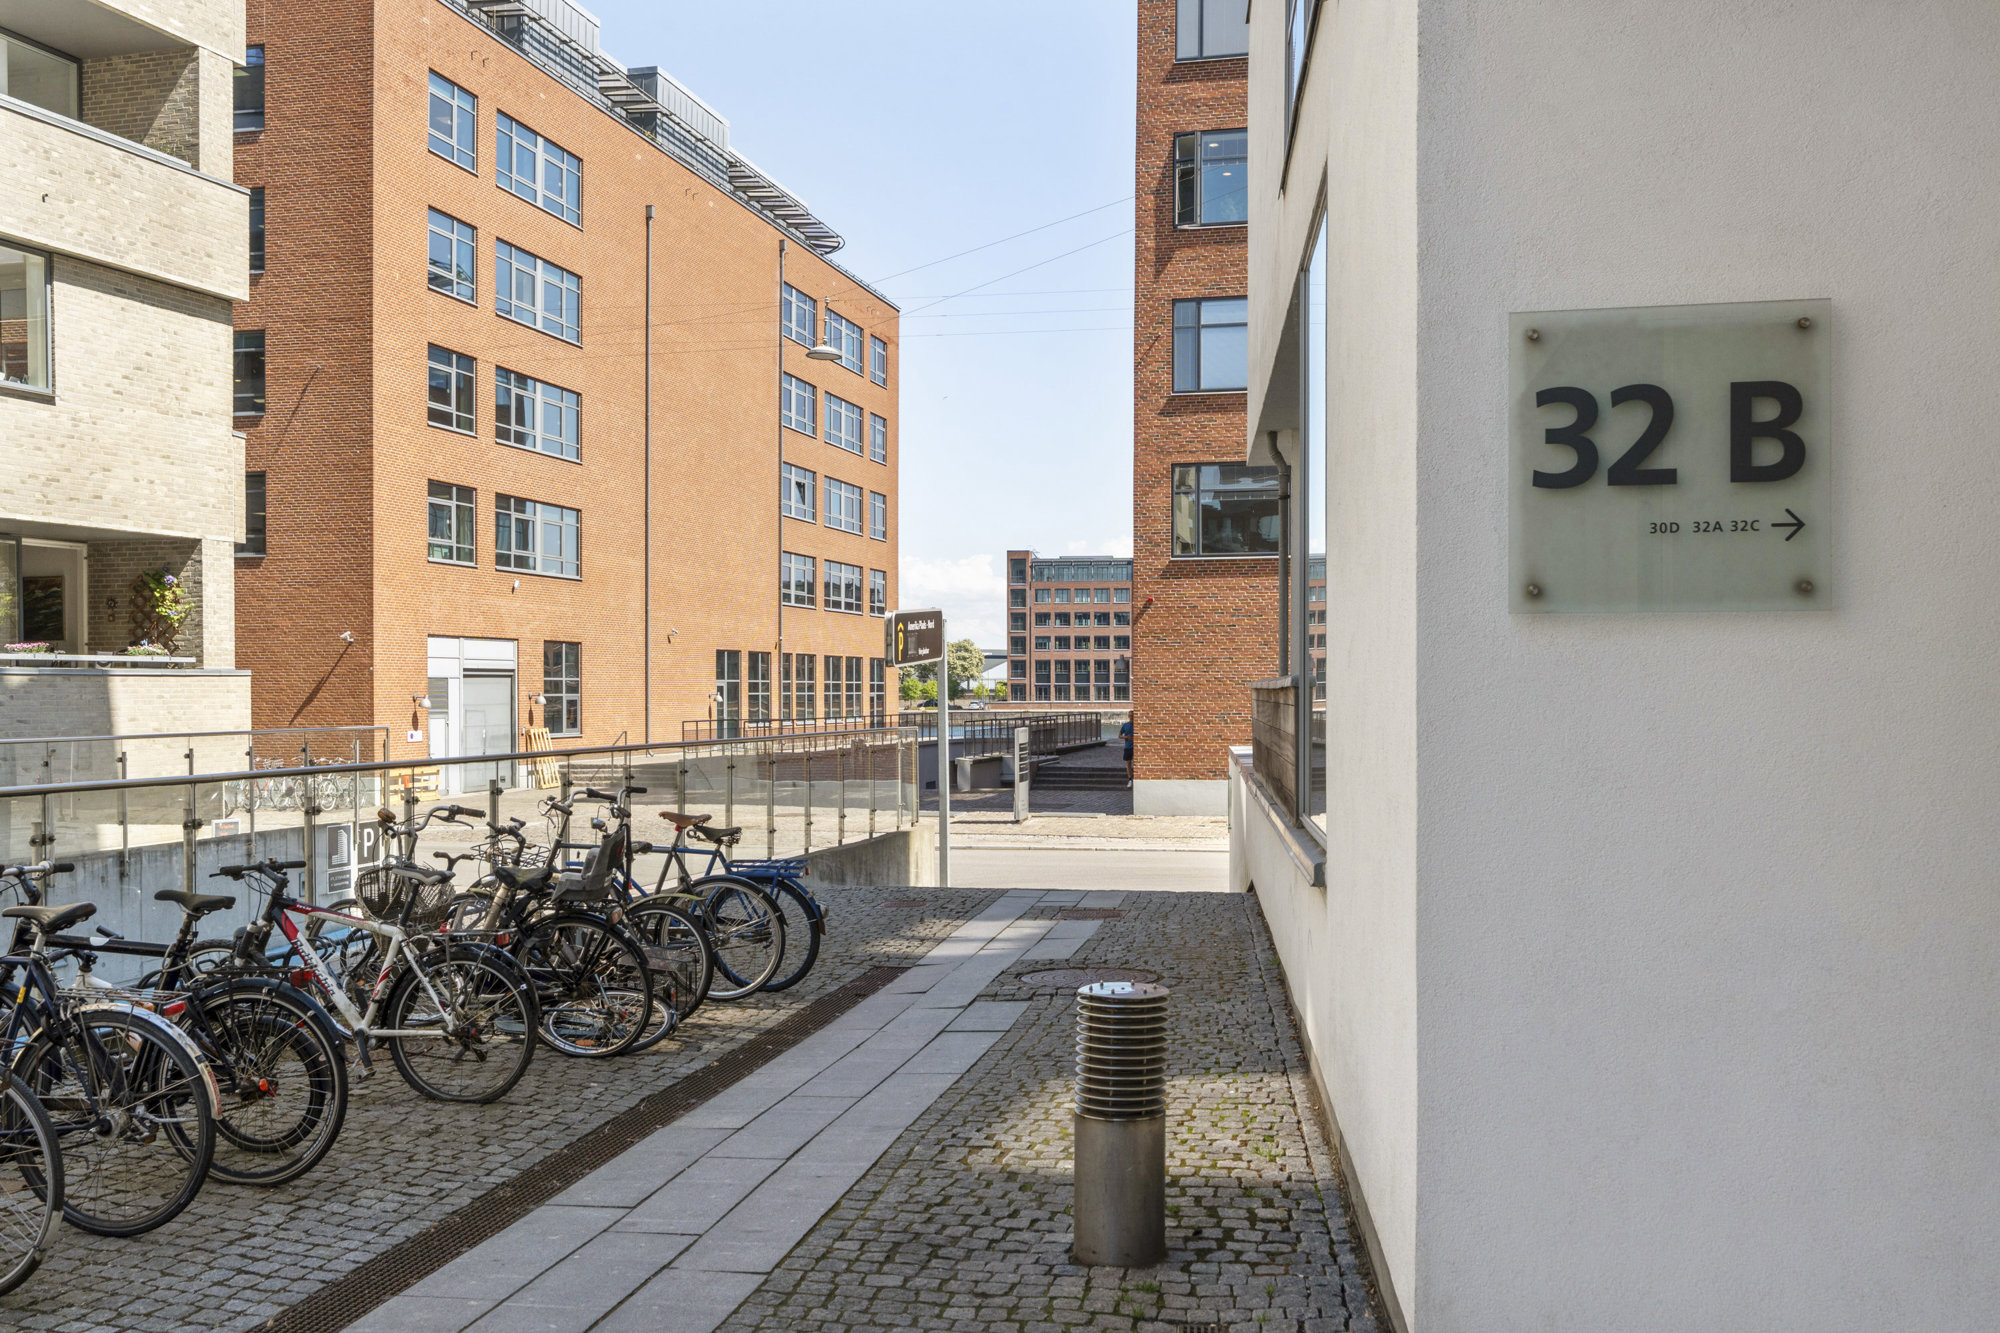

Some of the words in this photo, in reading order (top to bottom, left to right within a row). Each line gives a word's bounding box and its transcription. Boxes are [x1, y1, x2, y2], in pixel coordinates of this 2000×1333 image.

[1532, 383, 1678, 489] 32
[1730, 380, 1806, 484] B
[1649, 521, 1680, 534] 30D
[1692, 521, 1724, 533] 32A
[1730, 519, 1760, 532] 32C
[363, 828, 375, 858] P
